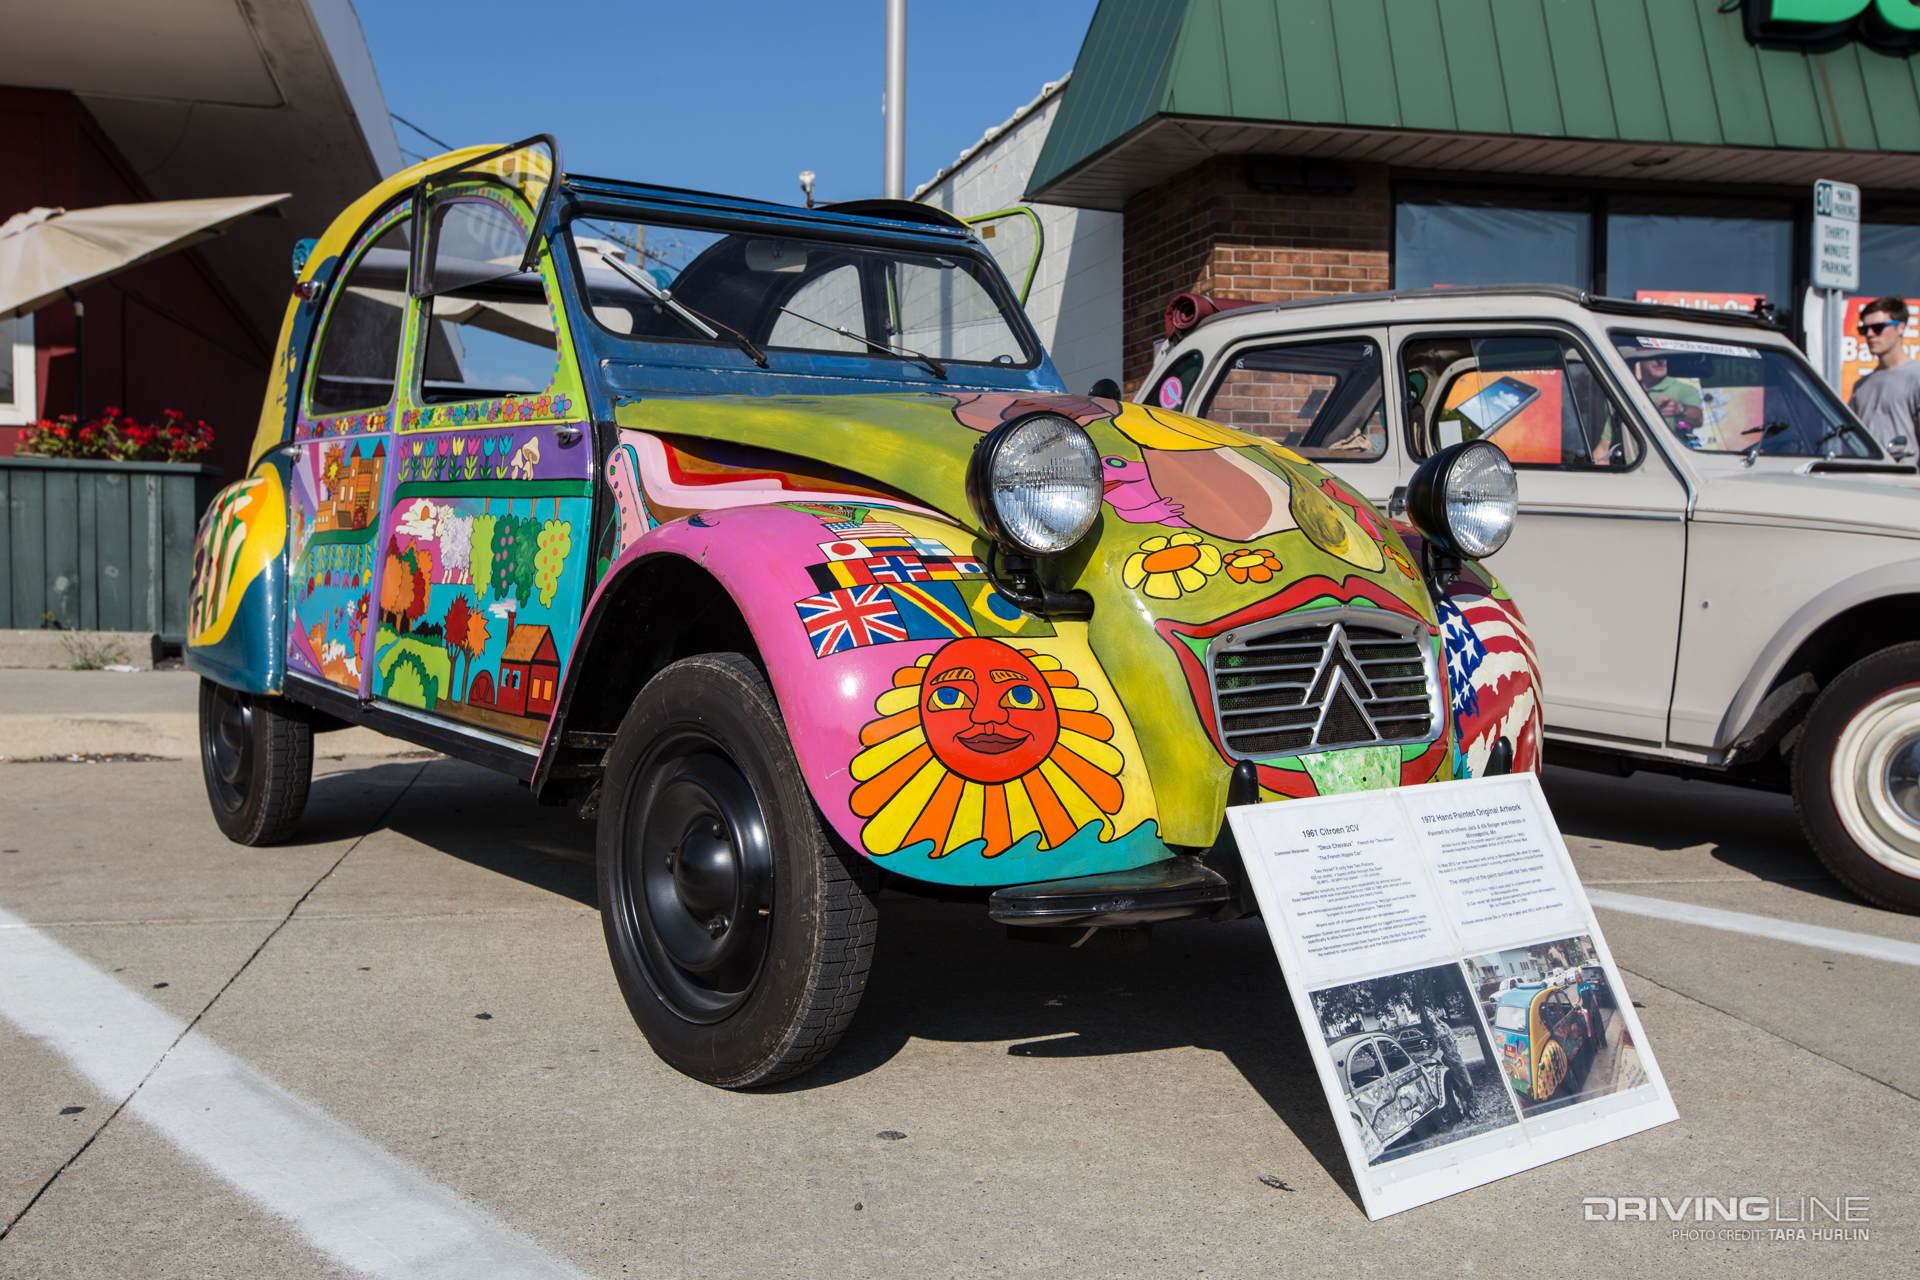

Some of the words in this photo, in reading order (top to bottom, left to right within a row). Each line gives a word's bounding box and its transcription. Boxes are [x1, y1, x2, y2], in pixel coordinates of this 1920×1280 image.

[1817, 184, 1832, 214] 30
[1824, 224, 1851, 241] THIRTY
[1822, 242, 1851, 260] MINUTE
[1820, 260, 1853, 278] PARKING
[1421, 815, 1437, 824] 1972
[1436, 813, 1453, 821] Hand
[1452, 810, 1476, 819] Painted
[1476, 807, 1499, 817] Original
[1499, 804, 1521, 812] Artwork
[1302, 829, 1318, 838] 1961
[1319, 827, 1345, 836] Citroen
[1345, 824, 1359, 833] 2CV
